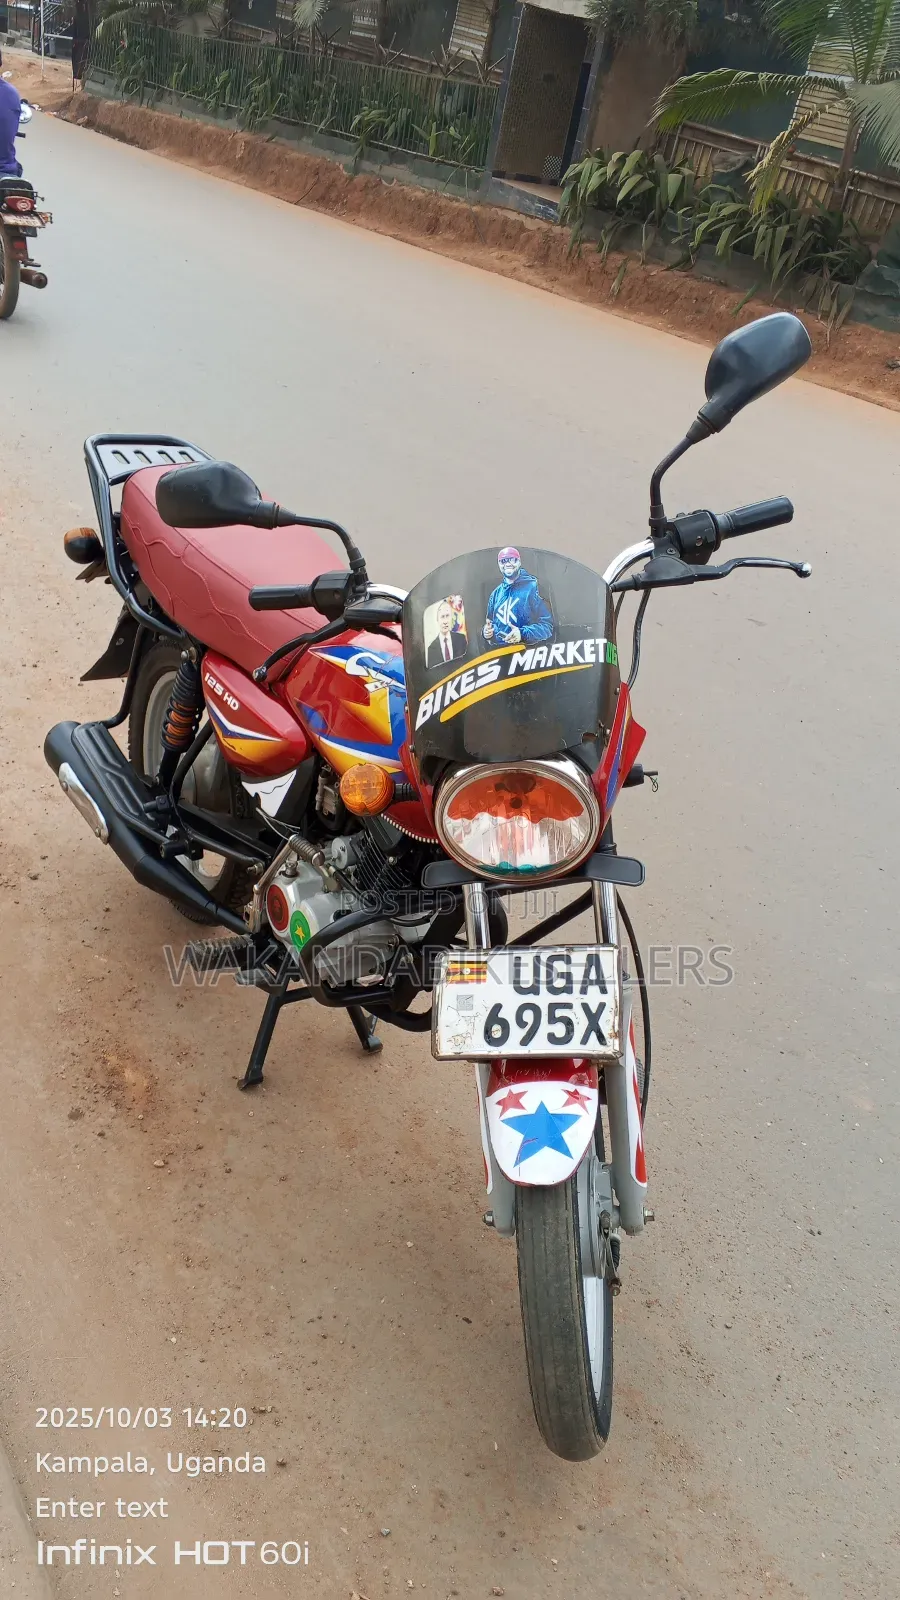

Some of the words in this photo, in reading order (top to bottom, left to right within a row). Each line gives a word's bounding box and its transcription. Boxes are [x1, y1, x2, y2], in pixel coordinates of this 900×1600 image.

[204, 672, 223, 695] 125
[223, 693, 240, 711] HD
[415, 658, 503, 731] BIKES
[513, 953, 608, 996] UGA
[483, 1001, 607, 1047] 695X
